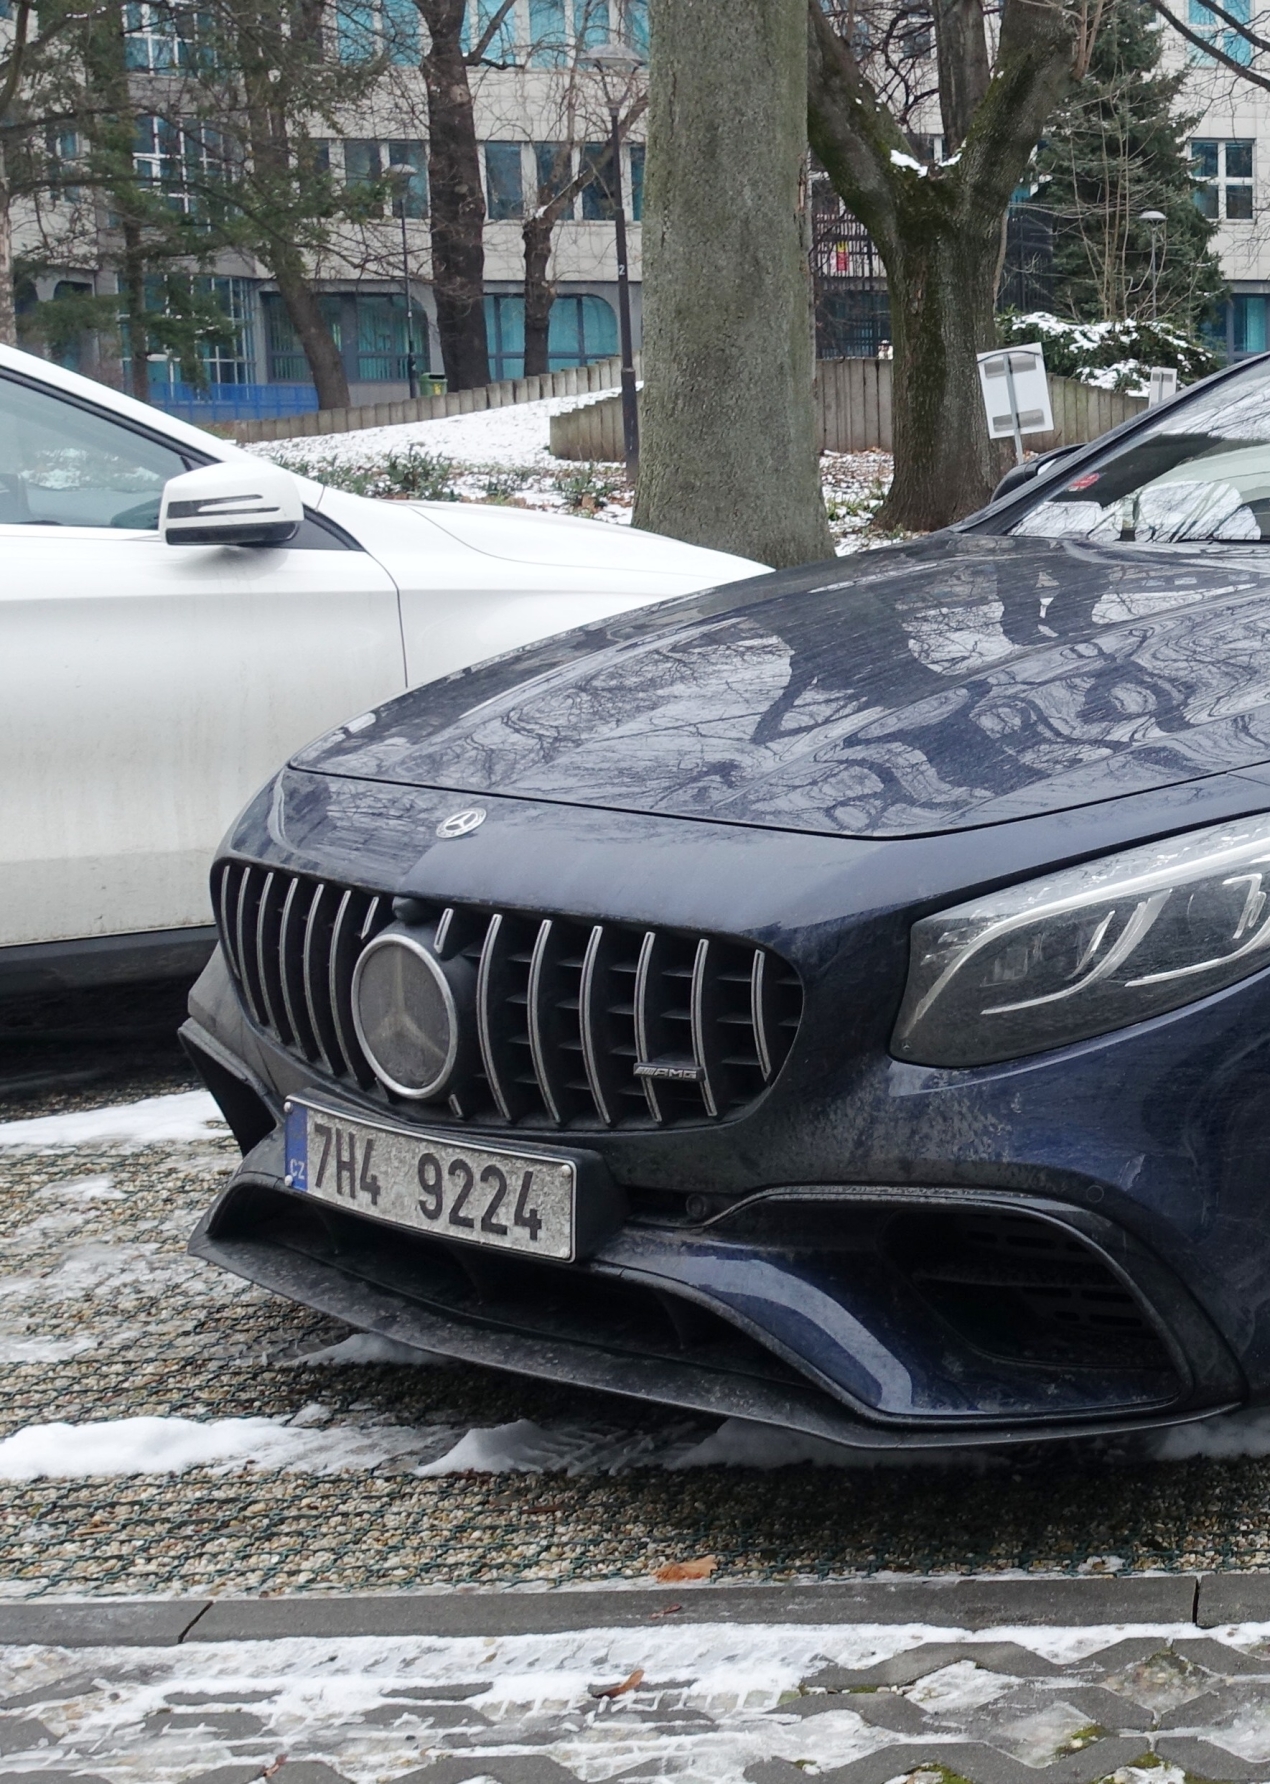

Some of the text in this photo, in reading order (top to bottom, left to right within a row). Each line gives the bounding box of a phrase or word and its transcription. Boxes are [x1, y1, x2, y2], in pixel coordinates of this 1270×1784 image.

[653, 1067, 697, 1080] AMG
[289, 1158, 305, 1181] CZ
[313, 1123, 543, 1241] 7H4 9224
